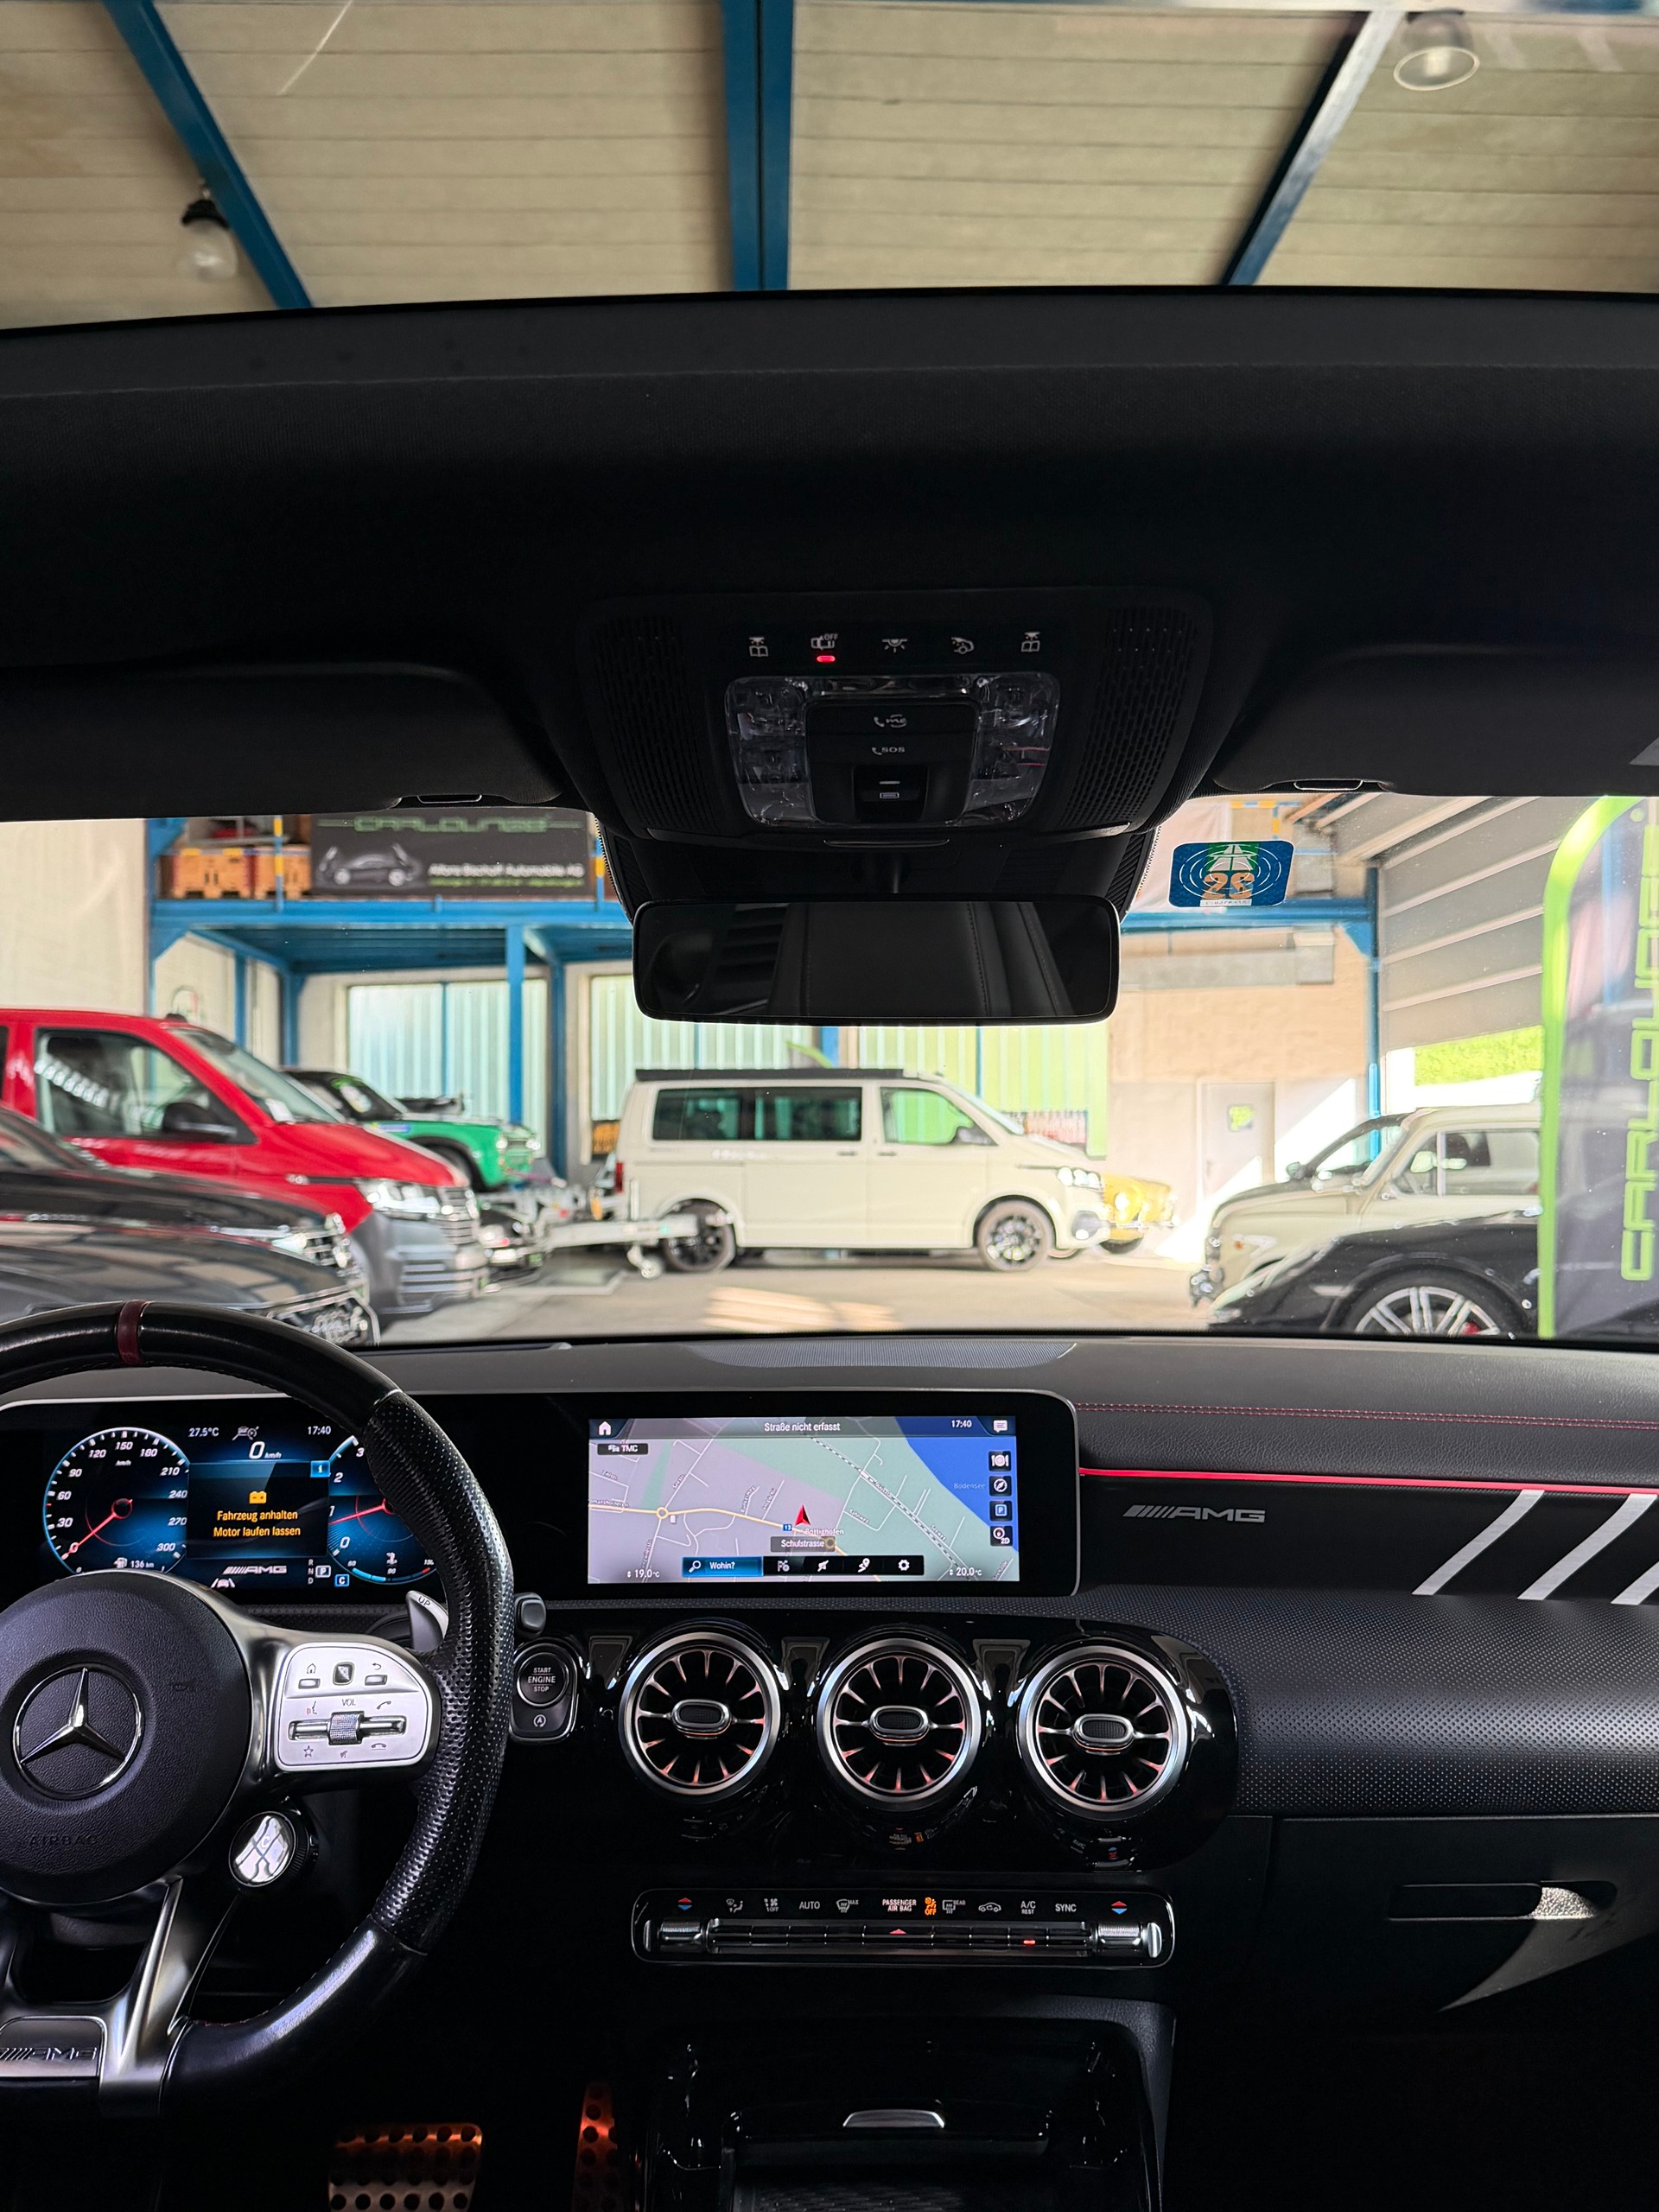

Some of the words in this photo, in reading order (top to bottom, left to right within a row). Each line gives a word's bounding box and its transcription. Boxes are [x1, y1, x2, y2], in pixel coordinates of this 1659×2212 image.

[764, 1421, 791, 1433] Straße
[792, 1421, 811, 1432] nicht
[812, 1421, 841, 1431] erfasst
[950, 1420, 972, 1428] 17:40
[308, 1426, 332, 1435] 17:40
[115, 1441, 133, 1451] 150
[248, 1440, 265, 1459] 0
[88, 1449, 107, 1459] 120
[139, 1448, 158, 1458] 180
[356, 1447, 365, 1458] 3
[67, 1468, 83, 1478] 90
[159, 1466, 181, 1476] 210
[334, 1471, 343, 1483] 2
[56, 1491, 72, 1500] 60
[168, 1490, 188, 1499] 240
[217, 1510, 258, 1522] Fahrzeug
[259, 1510, 298, 1520] anhalten
[1163, 1505, 1265, 1522] AMG
[56, 1517, 73, 1528] 30
[167, 1516, 188, 1526] 270
[213, 1527, 241, 1537] Motor
[242, 1526, 270, 1536] laufen
[272, 1526, 301, 1535] lassen
[156, 1542, 176, 1552] 300
[340, 1536, 351, 1548] 0
[240, 1565, 288, 1574] AMG
[709, 1561, 735, 1570] Wohin?
[339, 1576, 346, 1585] C
[418, 1595, 431, 1606] UP
[798, 1901, 821, 1910] AUTO
[1020, 1900, 1036, 1910] A/C
[1055, 1903, 1077, 1912] SYNC
